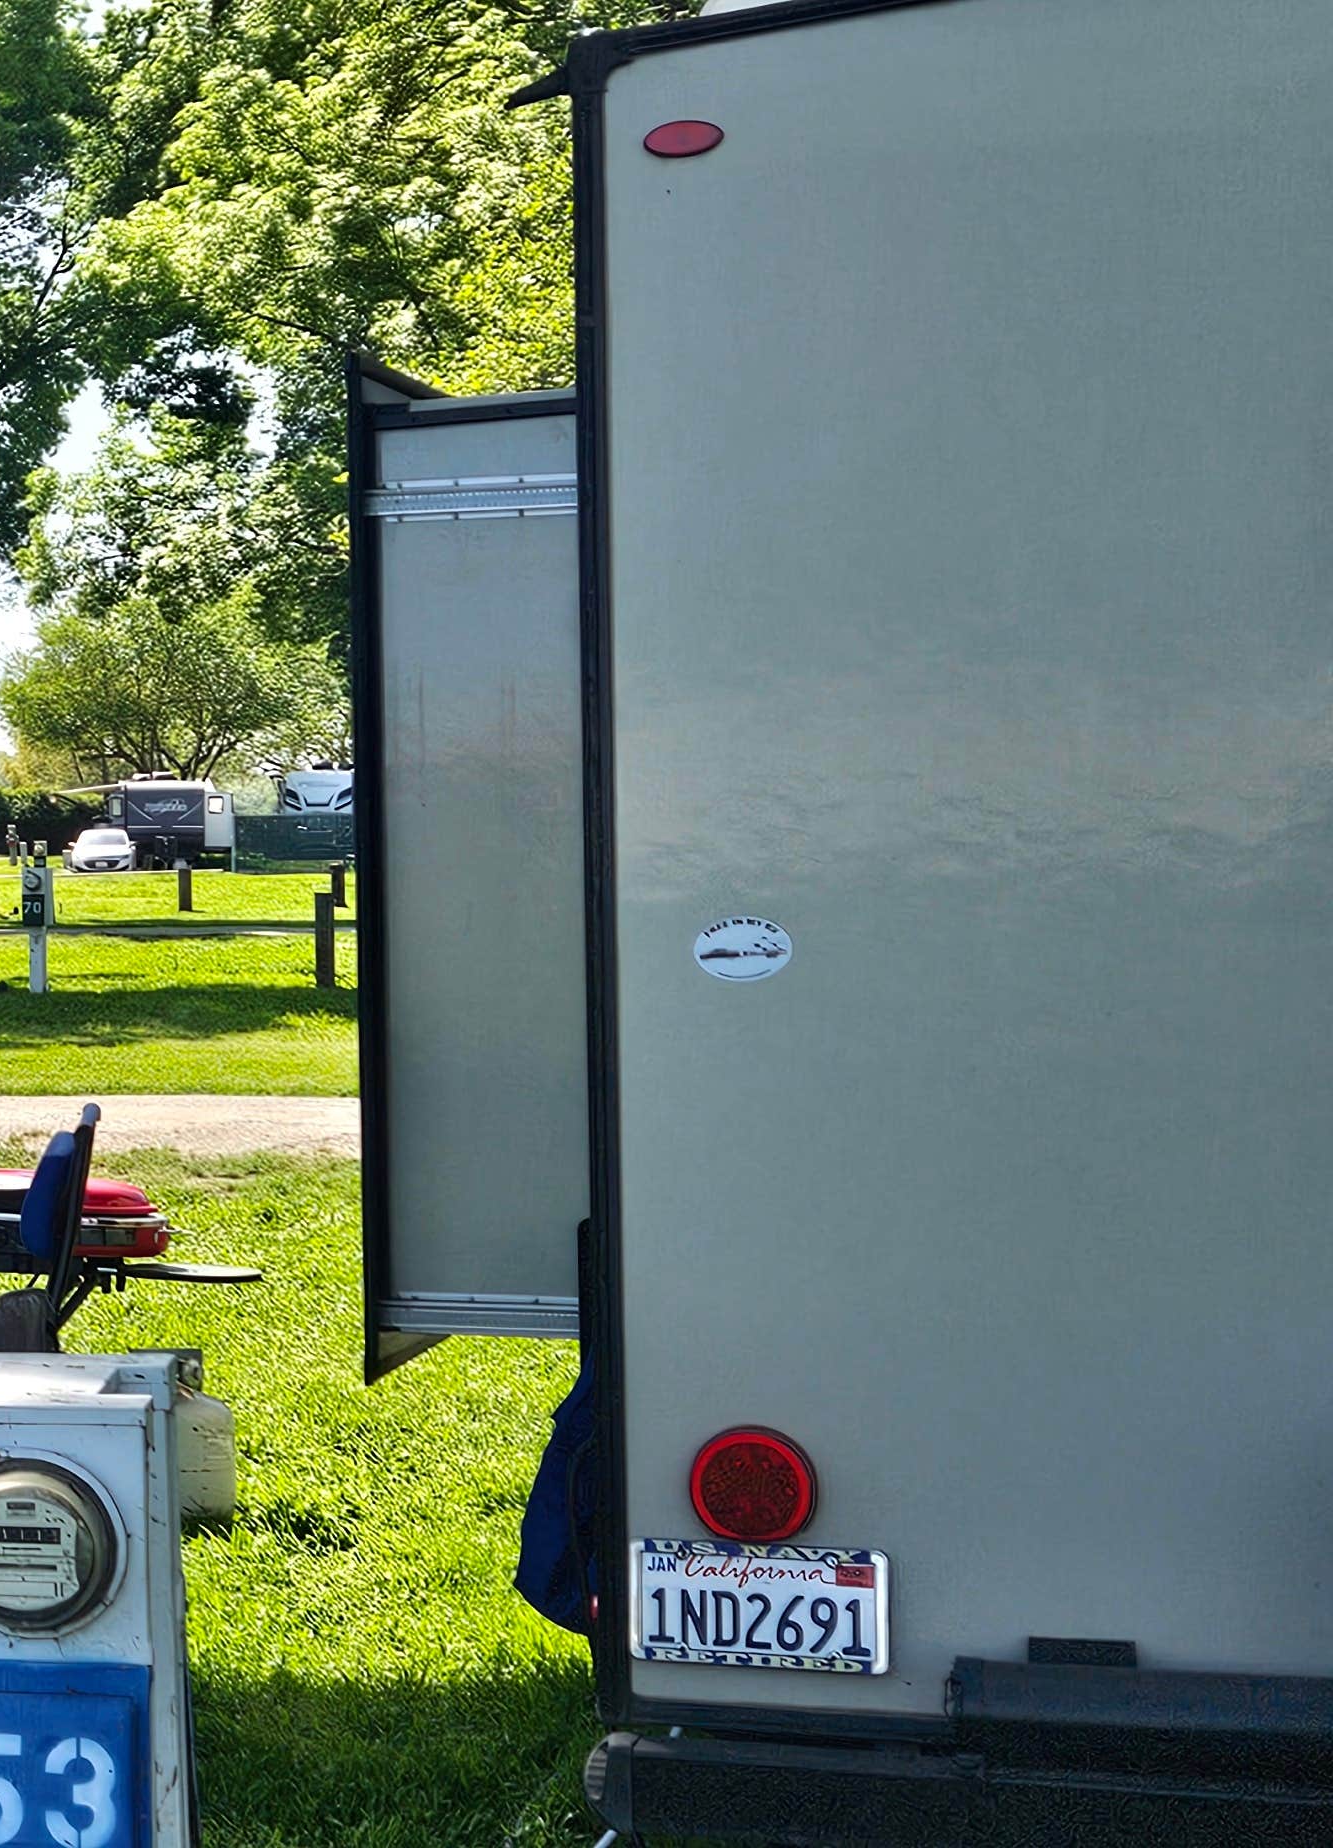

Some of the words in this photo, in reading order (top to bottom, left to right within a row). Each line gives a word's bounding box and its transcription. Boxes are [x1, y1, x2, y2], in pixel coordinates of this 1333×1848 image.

[23, 901, 42, 914] 70
[739, 1544, 858, 1562] NAVY
[647, 1556, 677, 1573] JAN
[683, 1553, 836, 1588] California
[647, 1587, 873, 1658] 1ND2691
[653, 1650, 864, 1673] RETIRED
